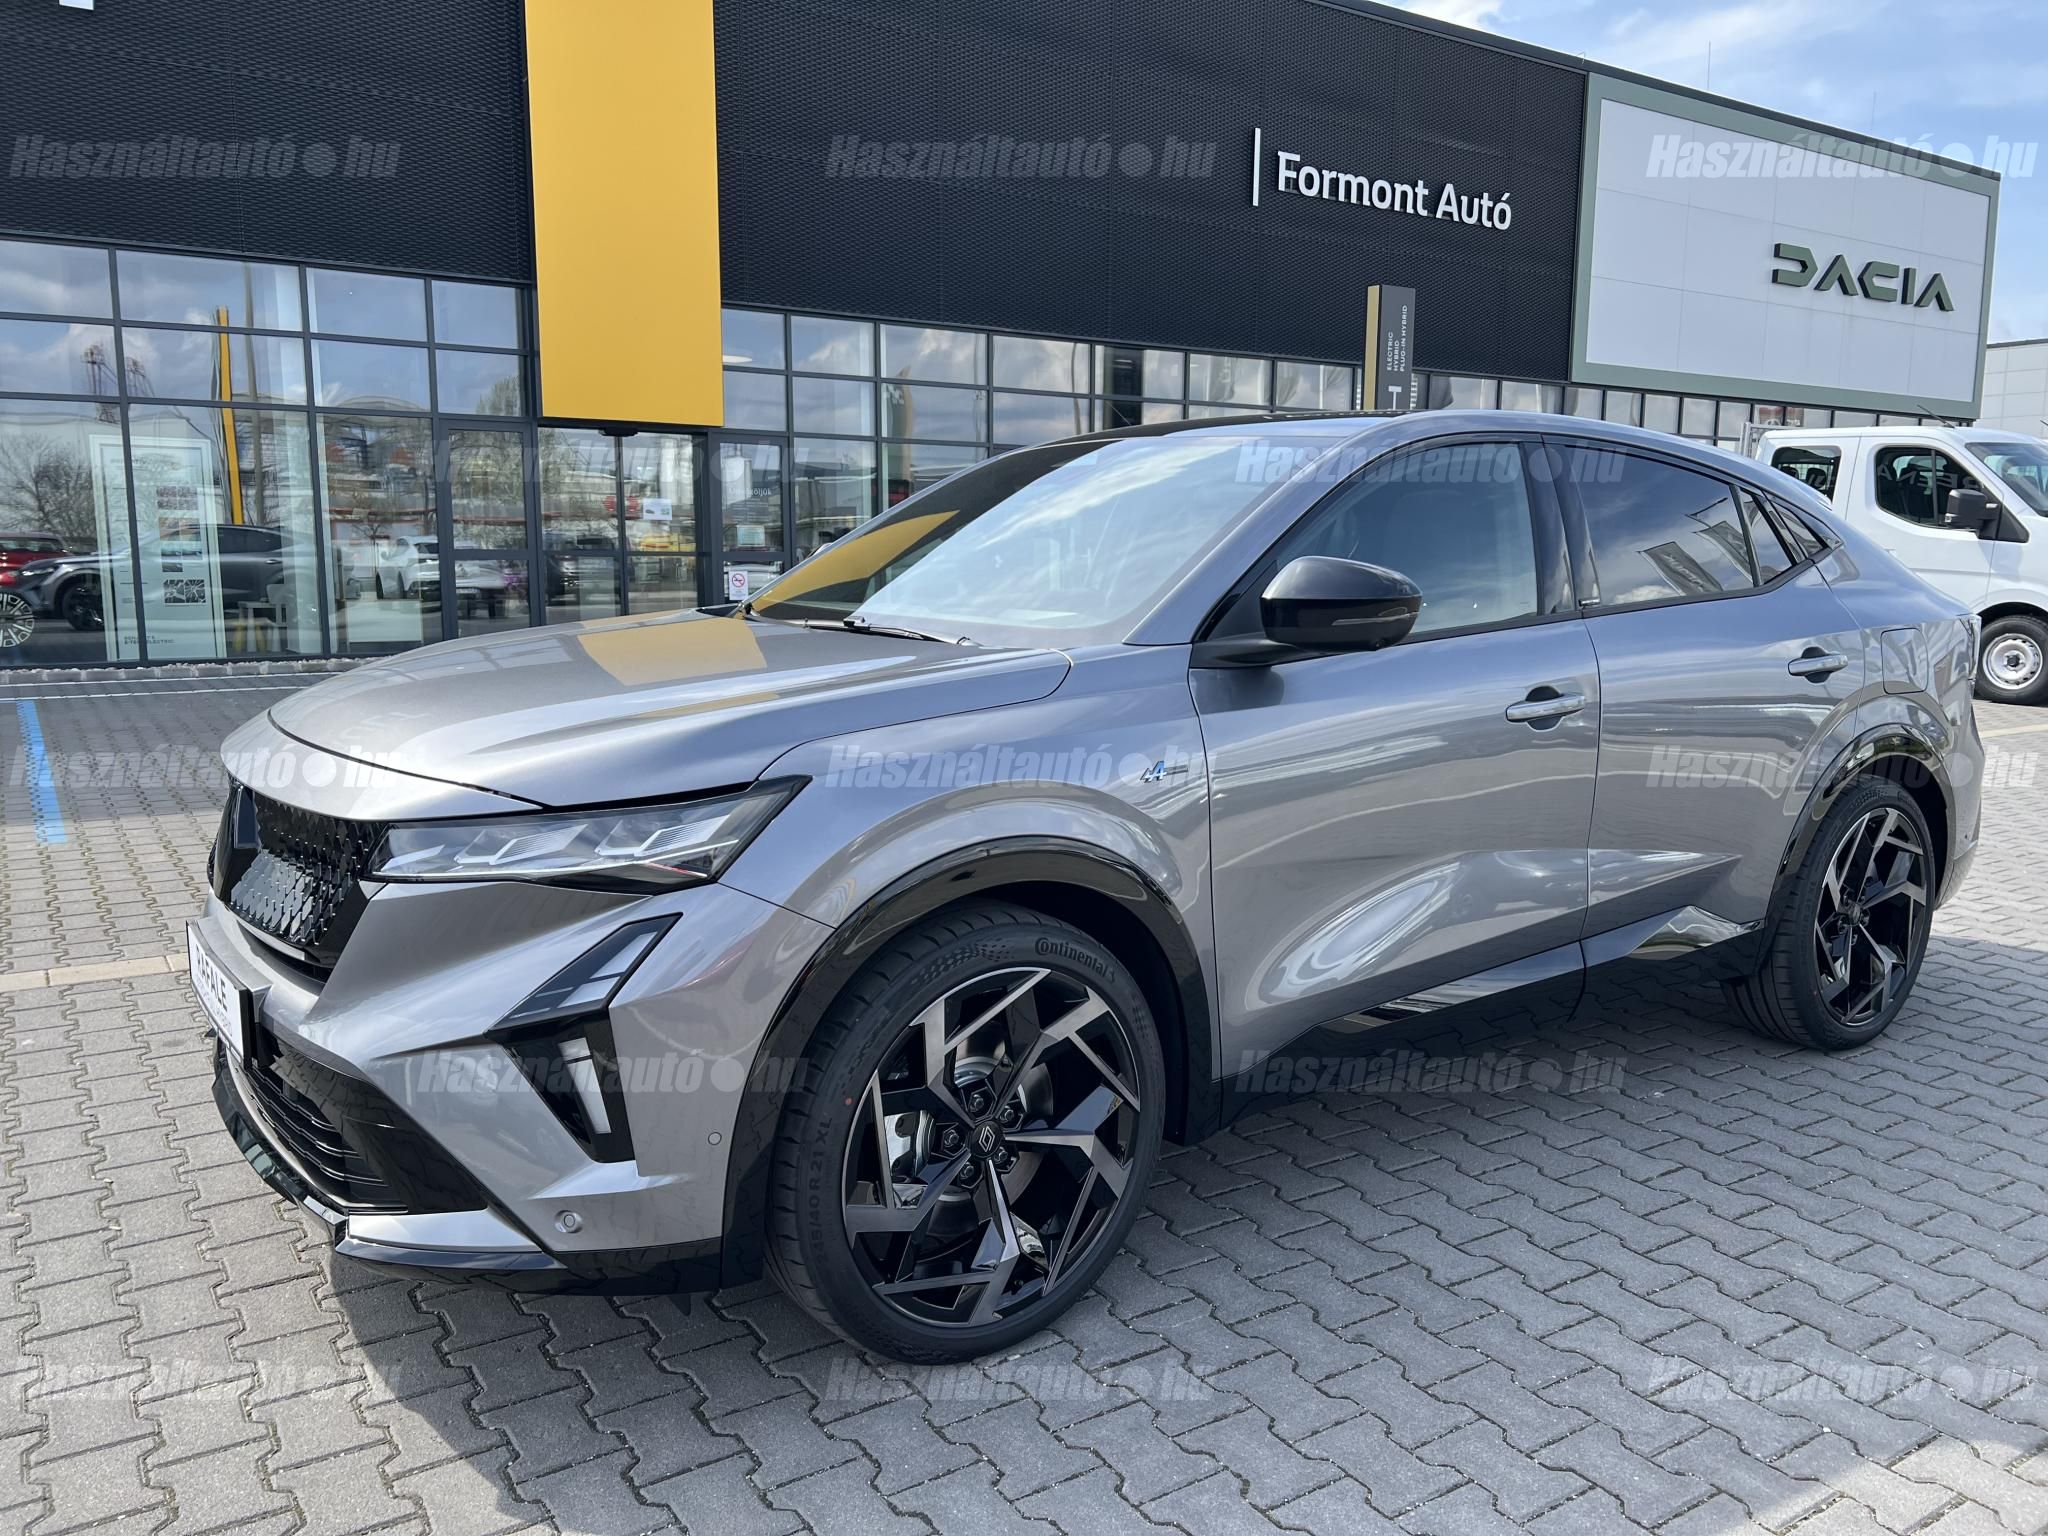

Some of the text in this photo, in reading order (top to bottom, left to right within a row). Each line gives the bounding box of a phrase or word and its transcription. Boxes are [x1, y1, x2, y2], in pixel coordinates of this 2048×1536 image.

[1277, 150, 1512, 231] Formont Autó
[1772, 243, 1955, 312] DACIA
[196, 943, 228, 1012] RAFALE
[1034, 936, 1109, 978] Continental
[815, 1116, 833, 1146] XL
